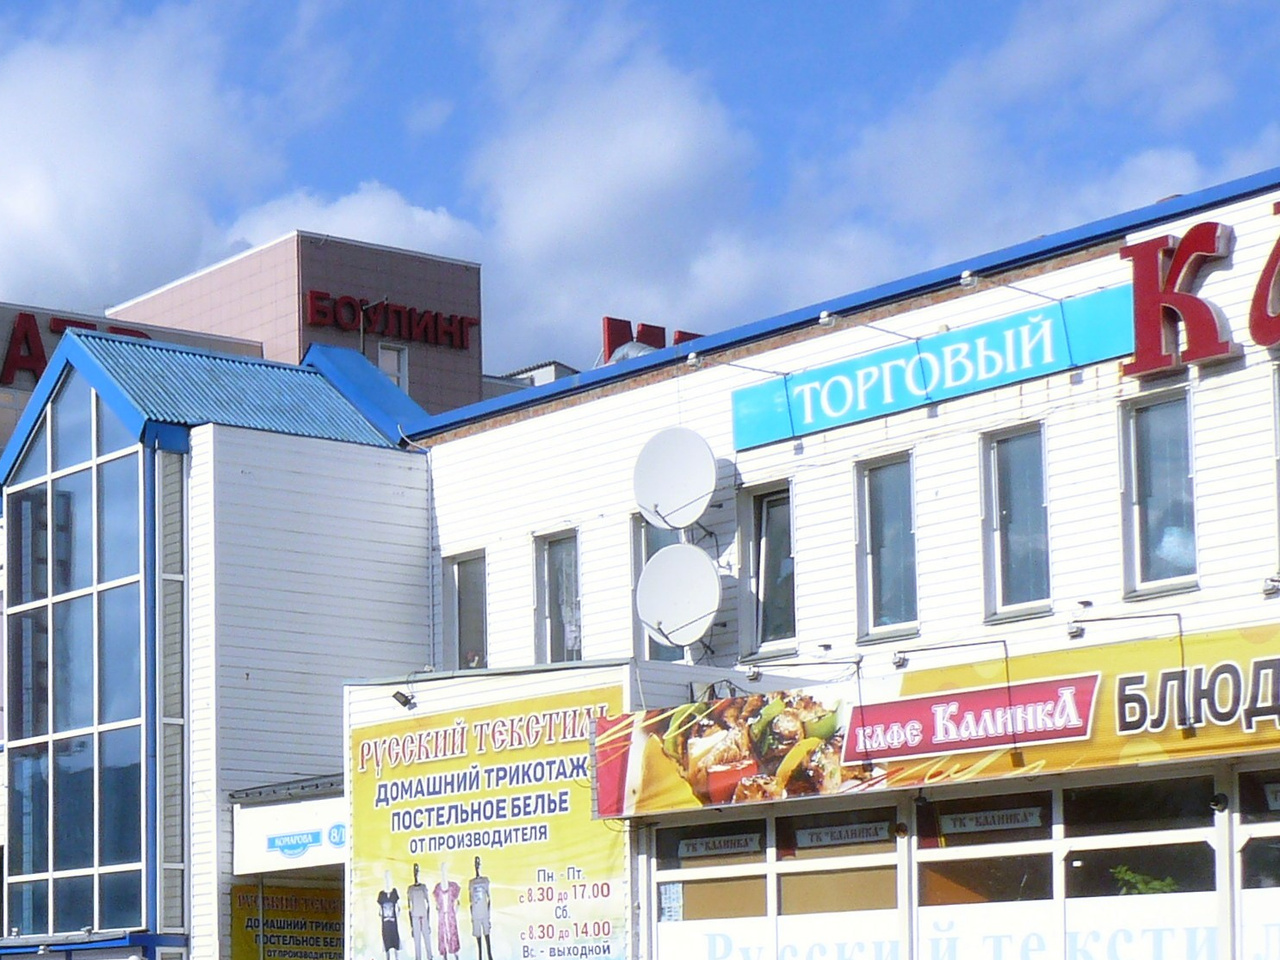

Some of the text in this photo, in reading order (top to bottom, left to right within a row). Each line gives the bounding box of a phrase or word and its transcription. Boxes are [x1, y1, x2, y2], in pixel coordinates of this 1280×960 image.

[307, 290, 480, 350] БОУЛИНГ
[793, 314, 1054, 424] ТОРГОВЫЙ
[359, 721, 468, 775] РУССКИЙ
[375, 757, 588, 807] ДОМАШНИЙ ТРИКОТАЖ
[391, 791, 569, 831] ПОСТЕЛЬНОЕ БЕЛЬЕ
[950, 816, 966, 828] ТК
[410, 825, 548, 853] ОТ ПРОИЗВОДИТЕЛЯ
[684, 842, 697, 852] ТК
[808, 832, 822, 843] ТК
[527, 887, 554, 903] 8.30
[557, 891, 568, 903] до
[572, 882, 610, 900] 17.00
[528, 924, 554, 940] 8.30
[558, 929, 569, 941] до
[573, 921, 611, 938] 14.00
[549, 941, 611, 959] выходной
